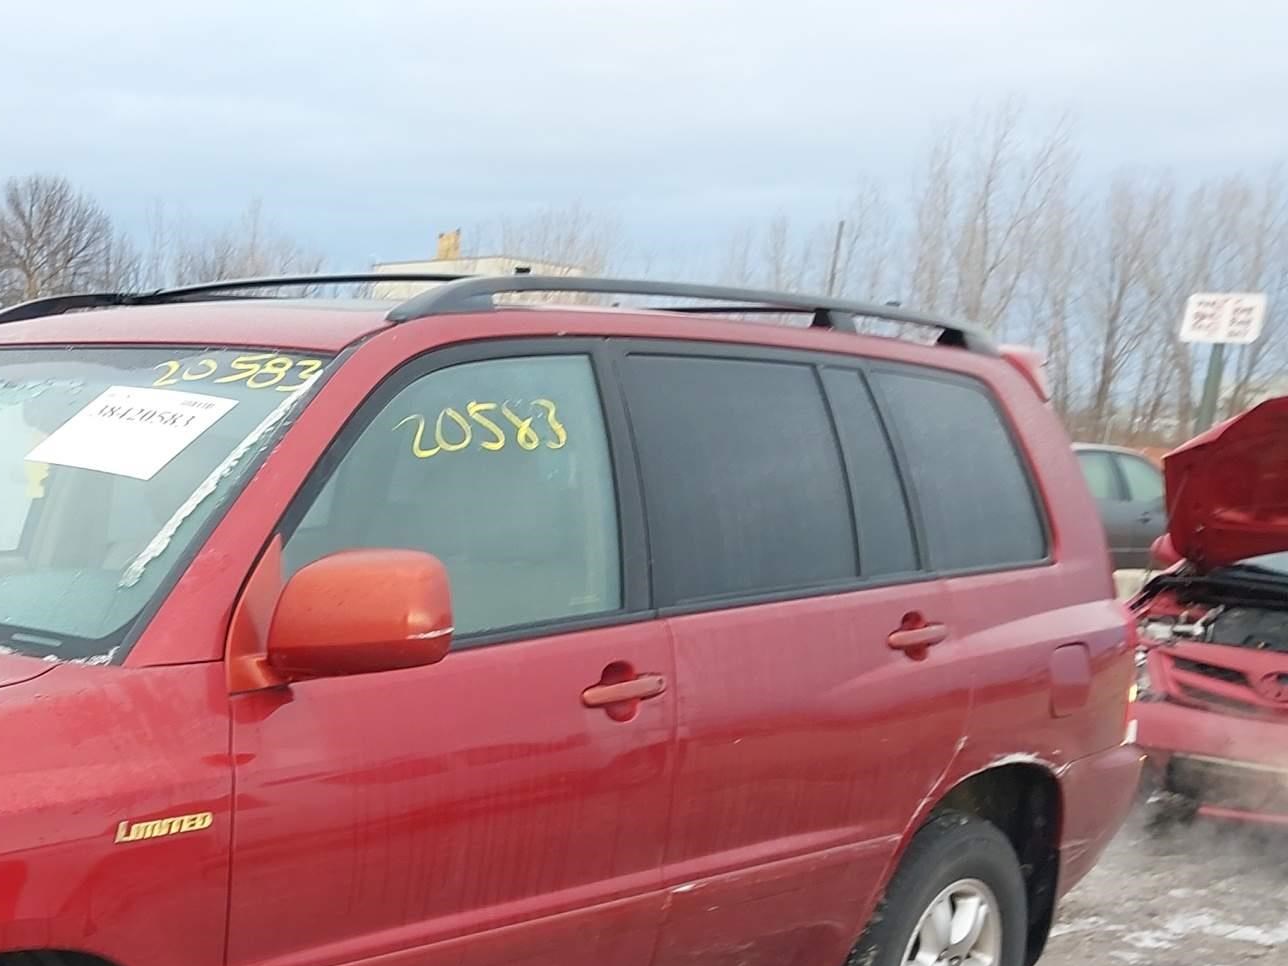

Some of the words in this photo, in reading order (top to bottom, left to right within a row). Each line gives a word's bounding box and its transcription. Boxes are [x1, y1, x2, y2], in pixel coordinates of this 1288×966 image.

[151, 353, 323, 392] 20583
[391, 398, 568, 458] 20583
[114, 811, 213, 844] LIMITED
